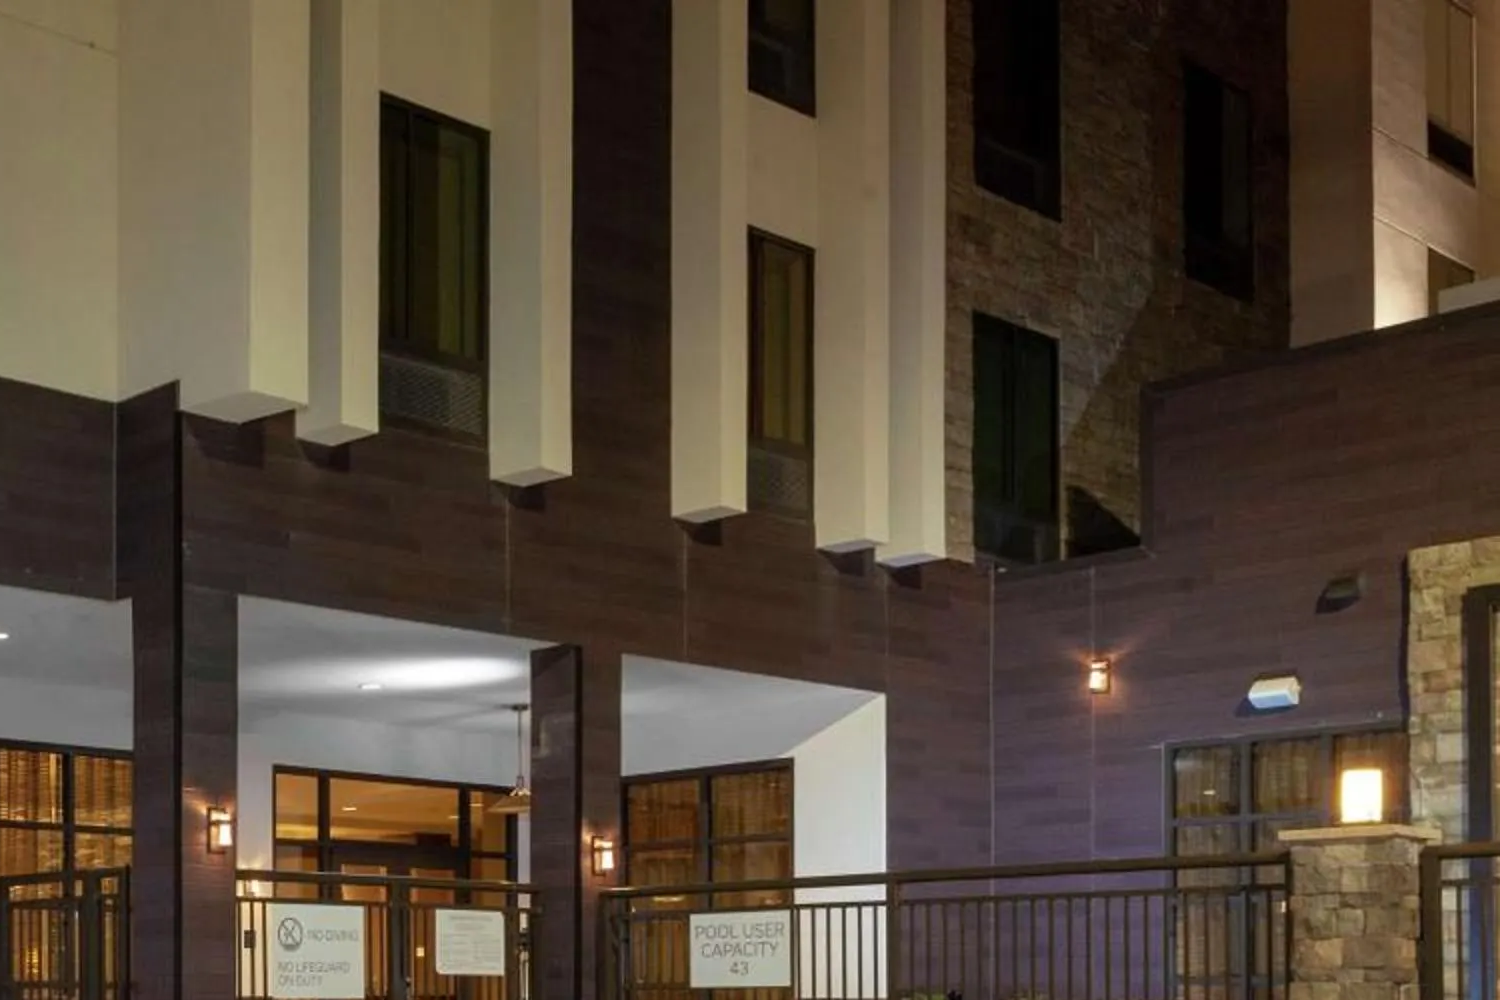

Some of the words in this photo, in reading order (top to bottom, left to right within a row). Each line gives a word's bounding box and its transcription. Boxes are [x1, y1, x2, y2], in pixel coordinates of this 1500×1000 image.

[307, 929, 323, 942] NO
[694, 924, 739, 940] POOL
[743, 921, 785, 939] USER
[701, 941, 779, 957] CAPACITY
[278, 961, 294, 973] NO
[729, 961, 749, 976] 43
